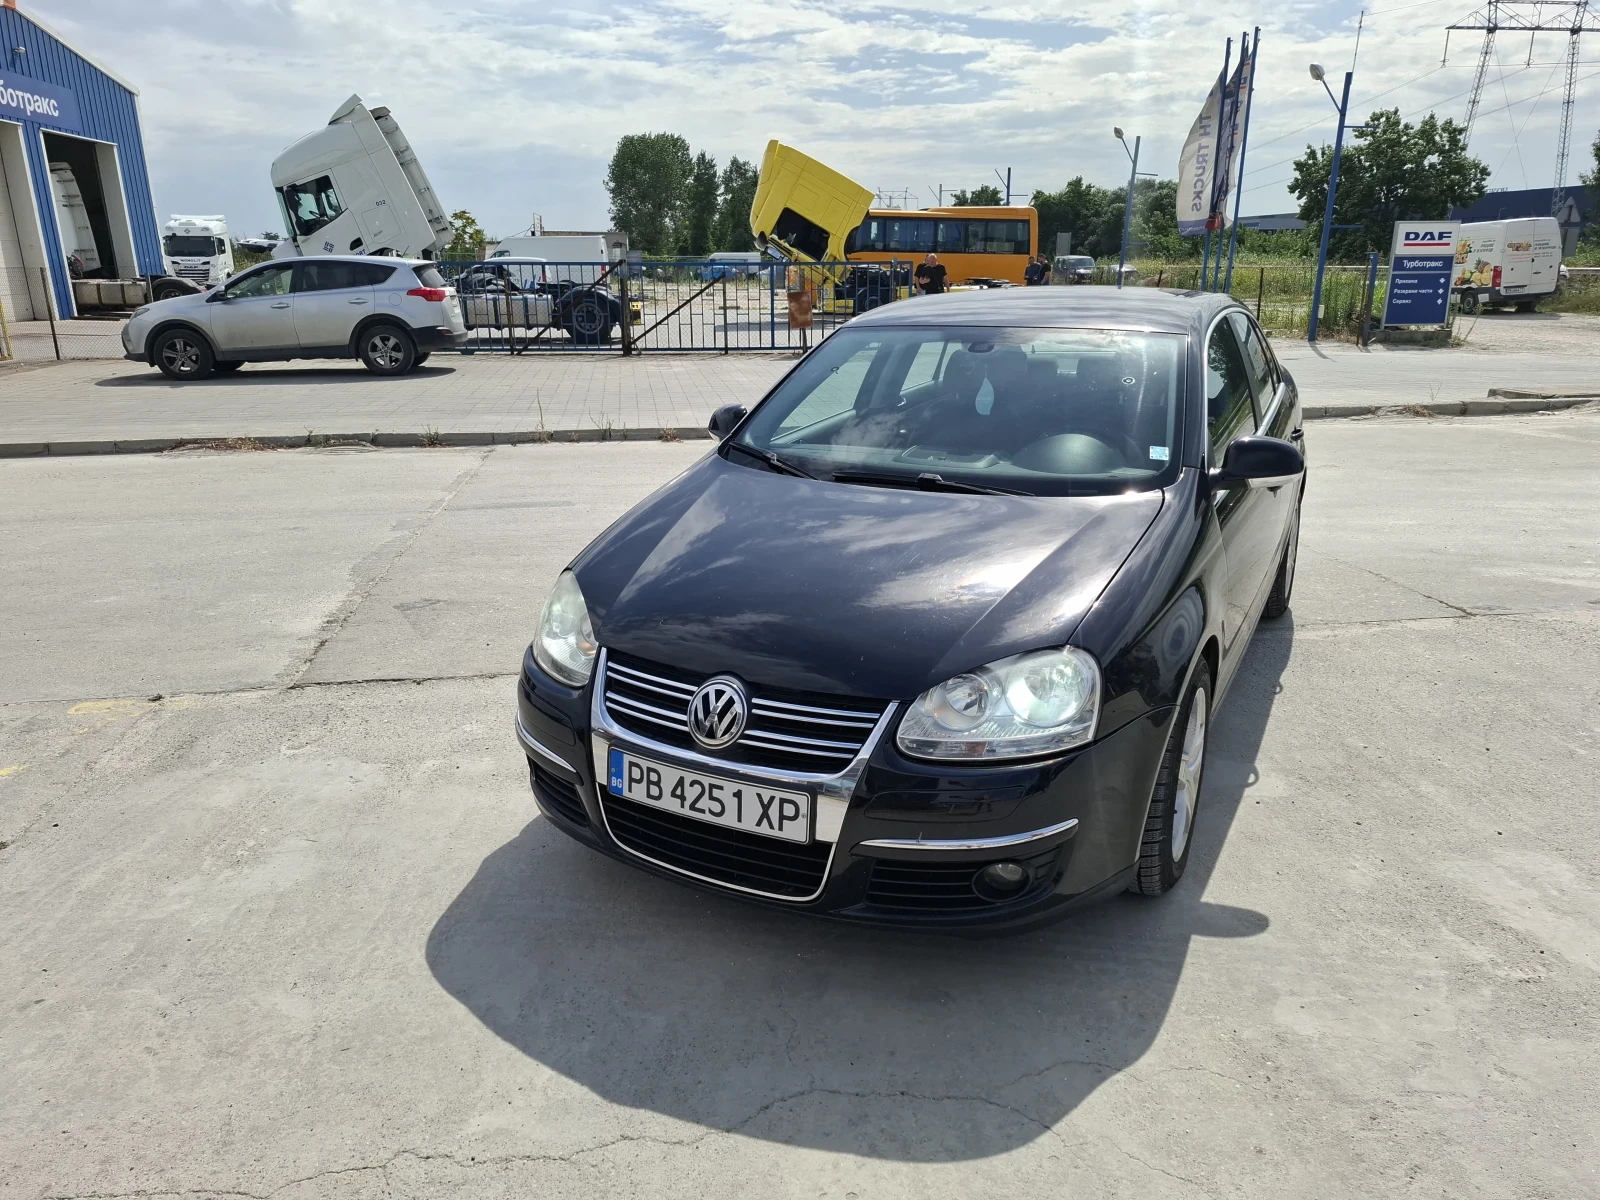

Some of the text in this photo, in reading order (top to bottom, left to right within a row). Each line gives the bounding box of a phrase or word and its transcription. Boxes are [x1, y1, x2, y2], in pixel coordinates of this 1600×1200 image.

[375, 199, 387, 207] 032
[1404, 231, 1453, 242] DAF
[1403, 260, 1443, 268] Турботракс
[611, 776, 623, 789] BG
[627, 760, 800, 832] PB 4251 XP
